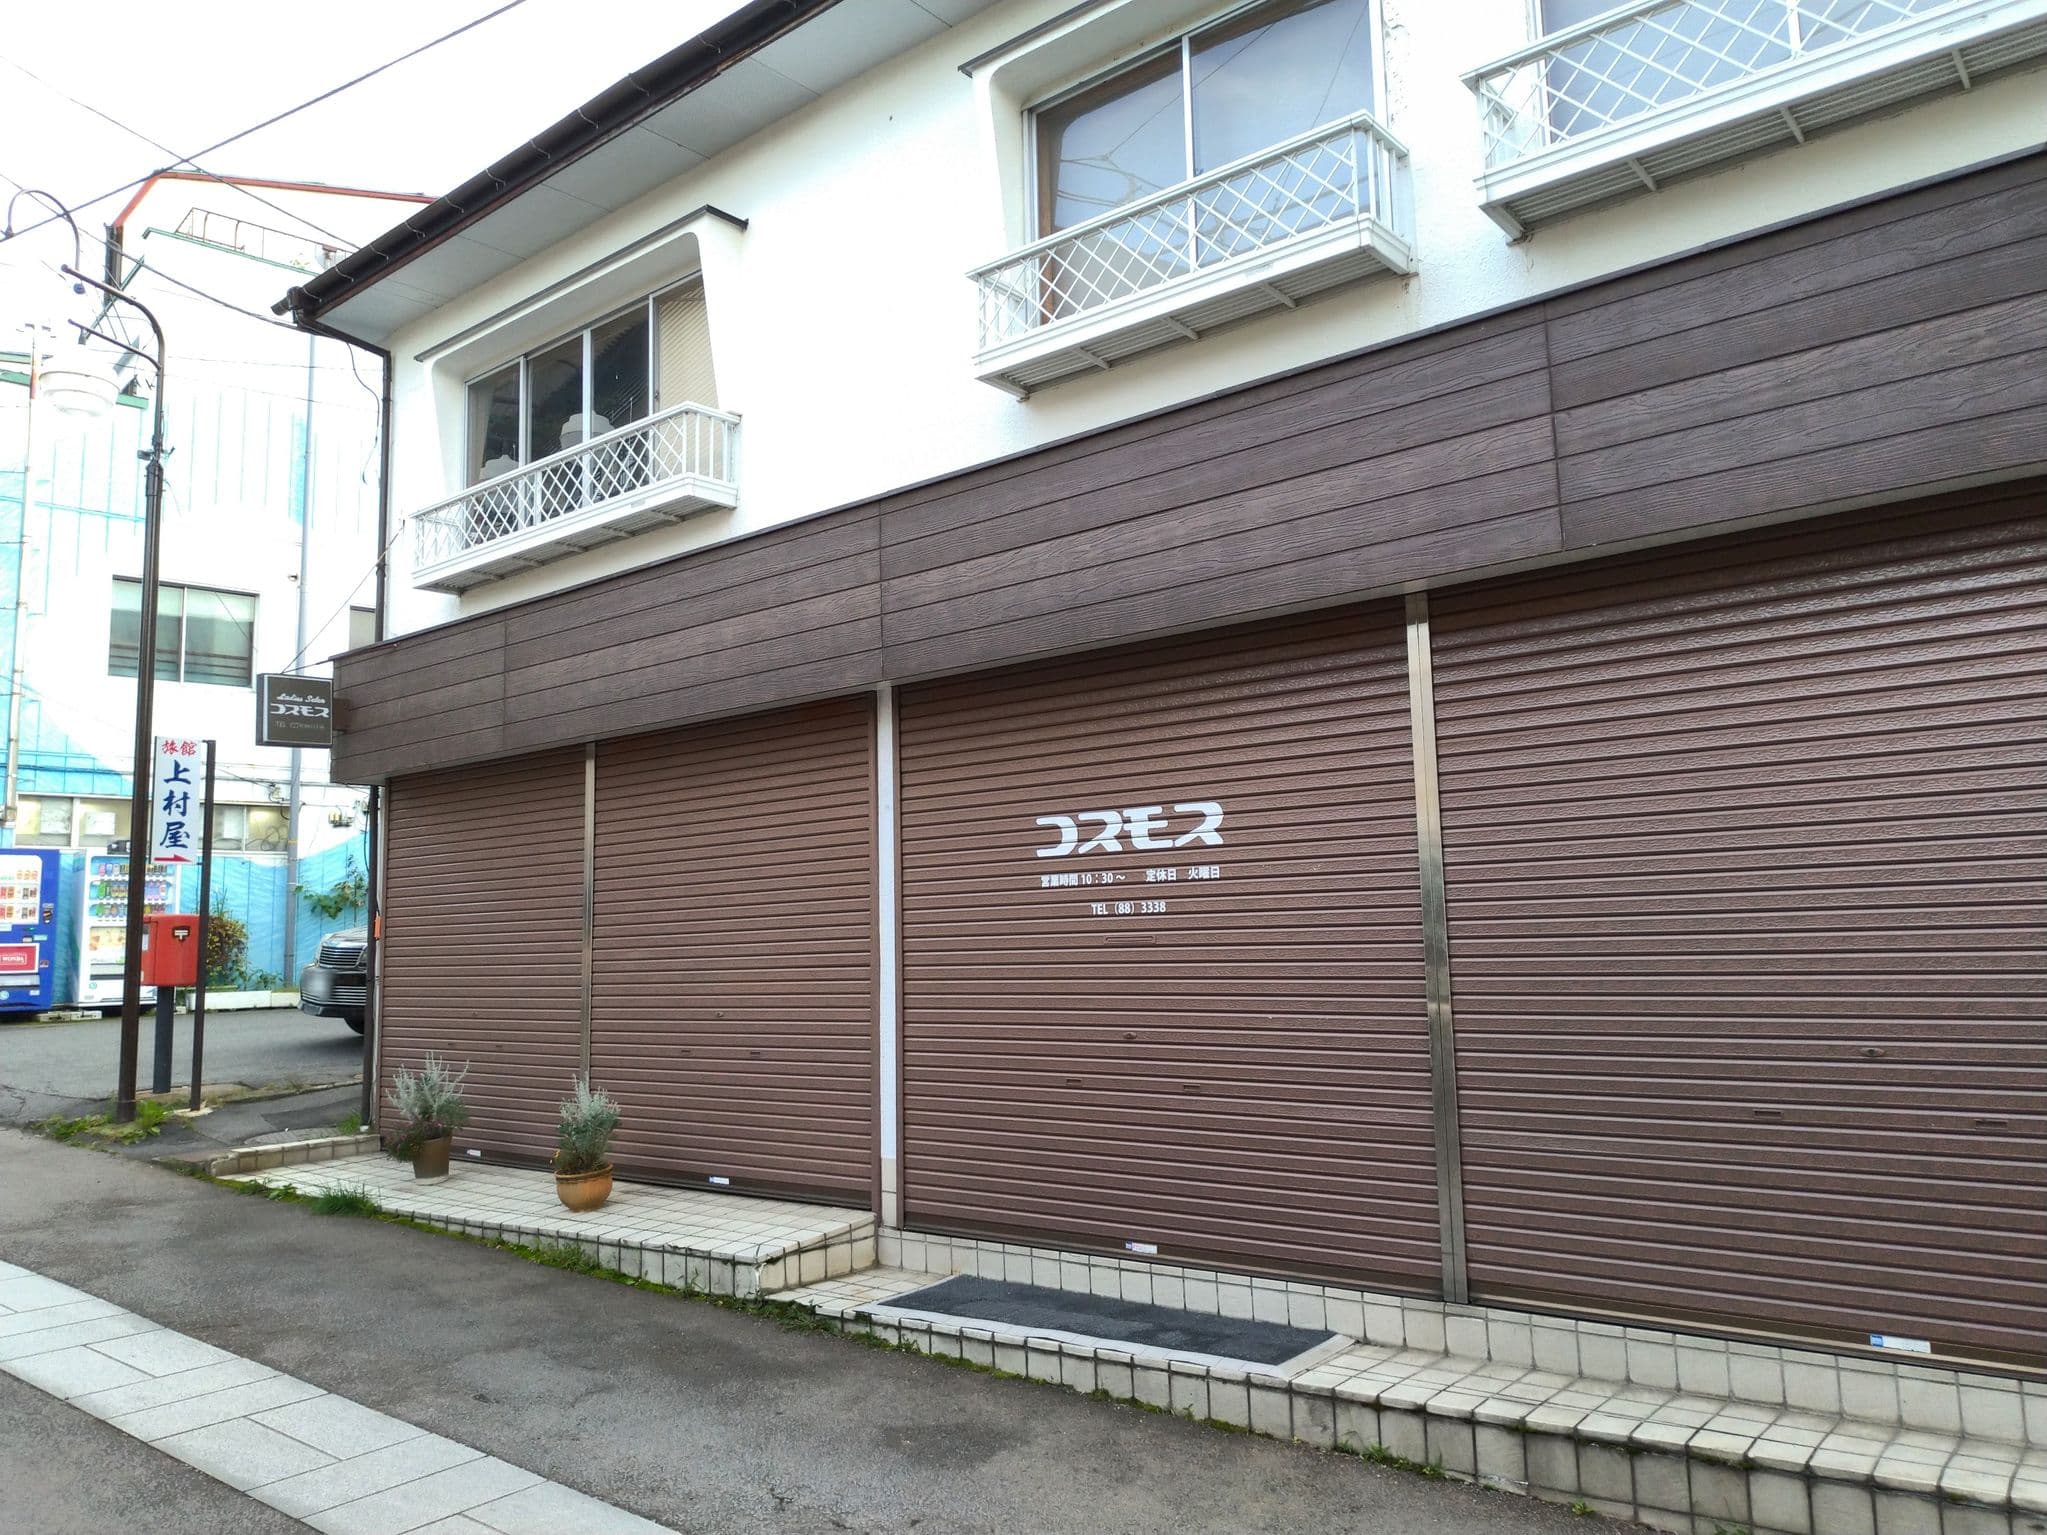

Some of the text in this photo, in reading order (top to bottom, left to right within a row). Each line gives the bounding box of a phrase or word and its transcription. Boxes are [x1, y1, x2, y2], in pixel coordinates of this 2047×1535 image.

[270, 702, 330, 718] コスモス
[162, 739, 197, 756] 旅館
[160, 759, 192, 849] 上村屋
[1034, 801, 1225, 858] コスモス
[1040, 873, 1079, 888] 営業時間
[1145, 868, 1177, 882] 定休日
[1188, 866, 1220, 880] 火曜日
[1090, 903, 1108, 915] TEL
[1140, 901, 1166, 914] 3338
